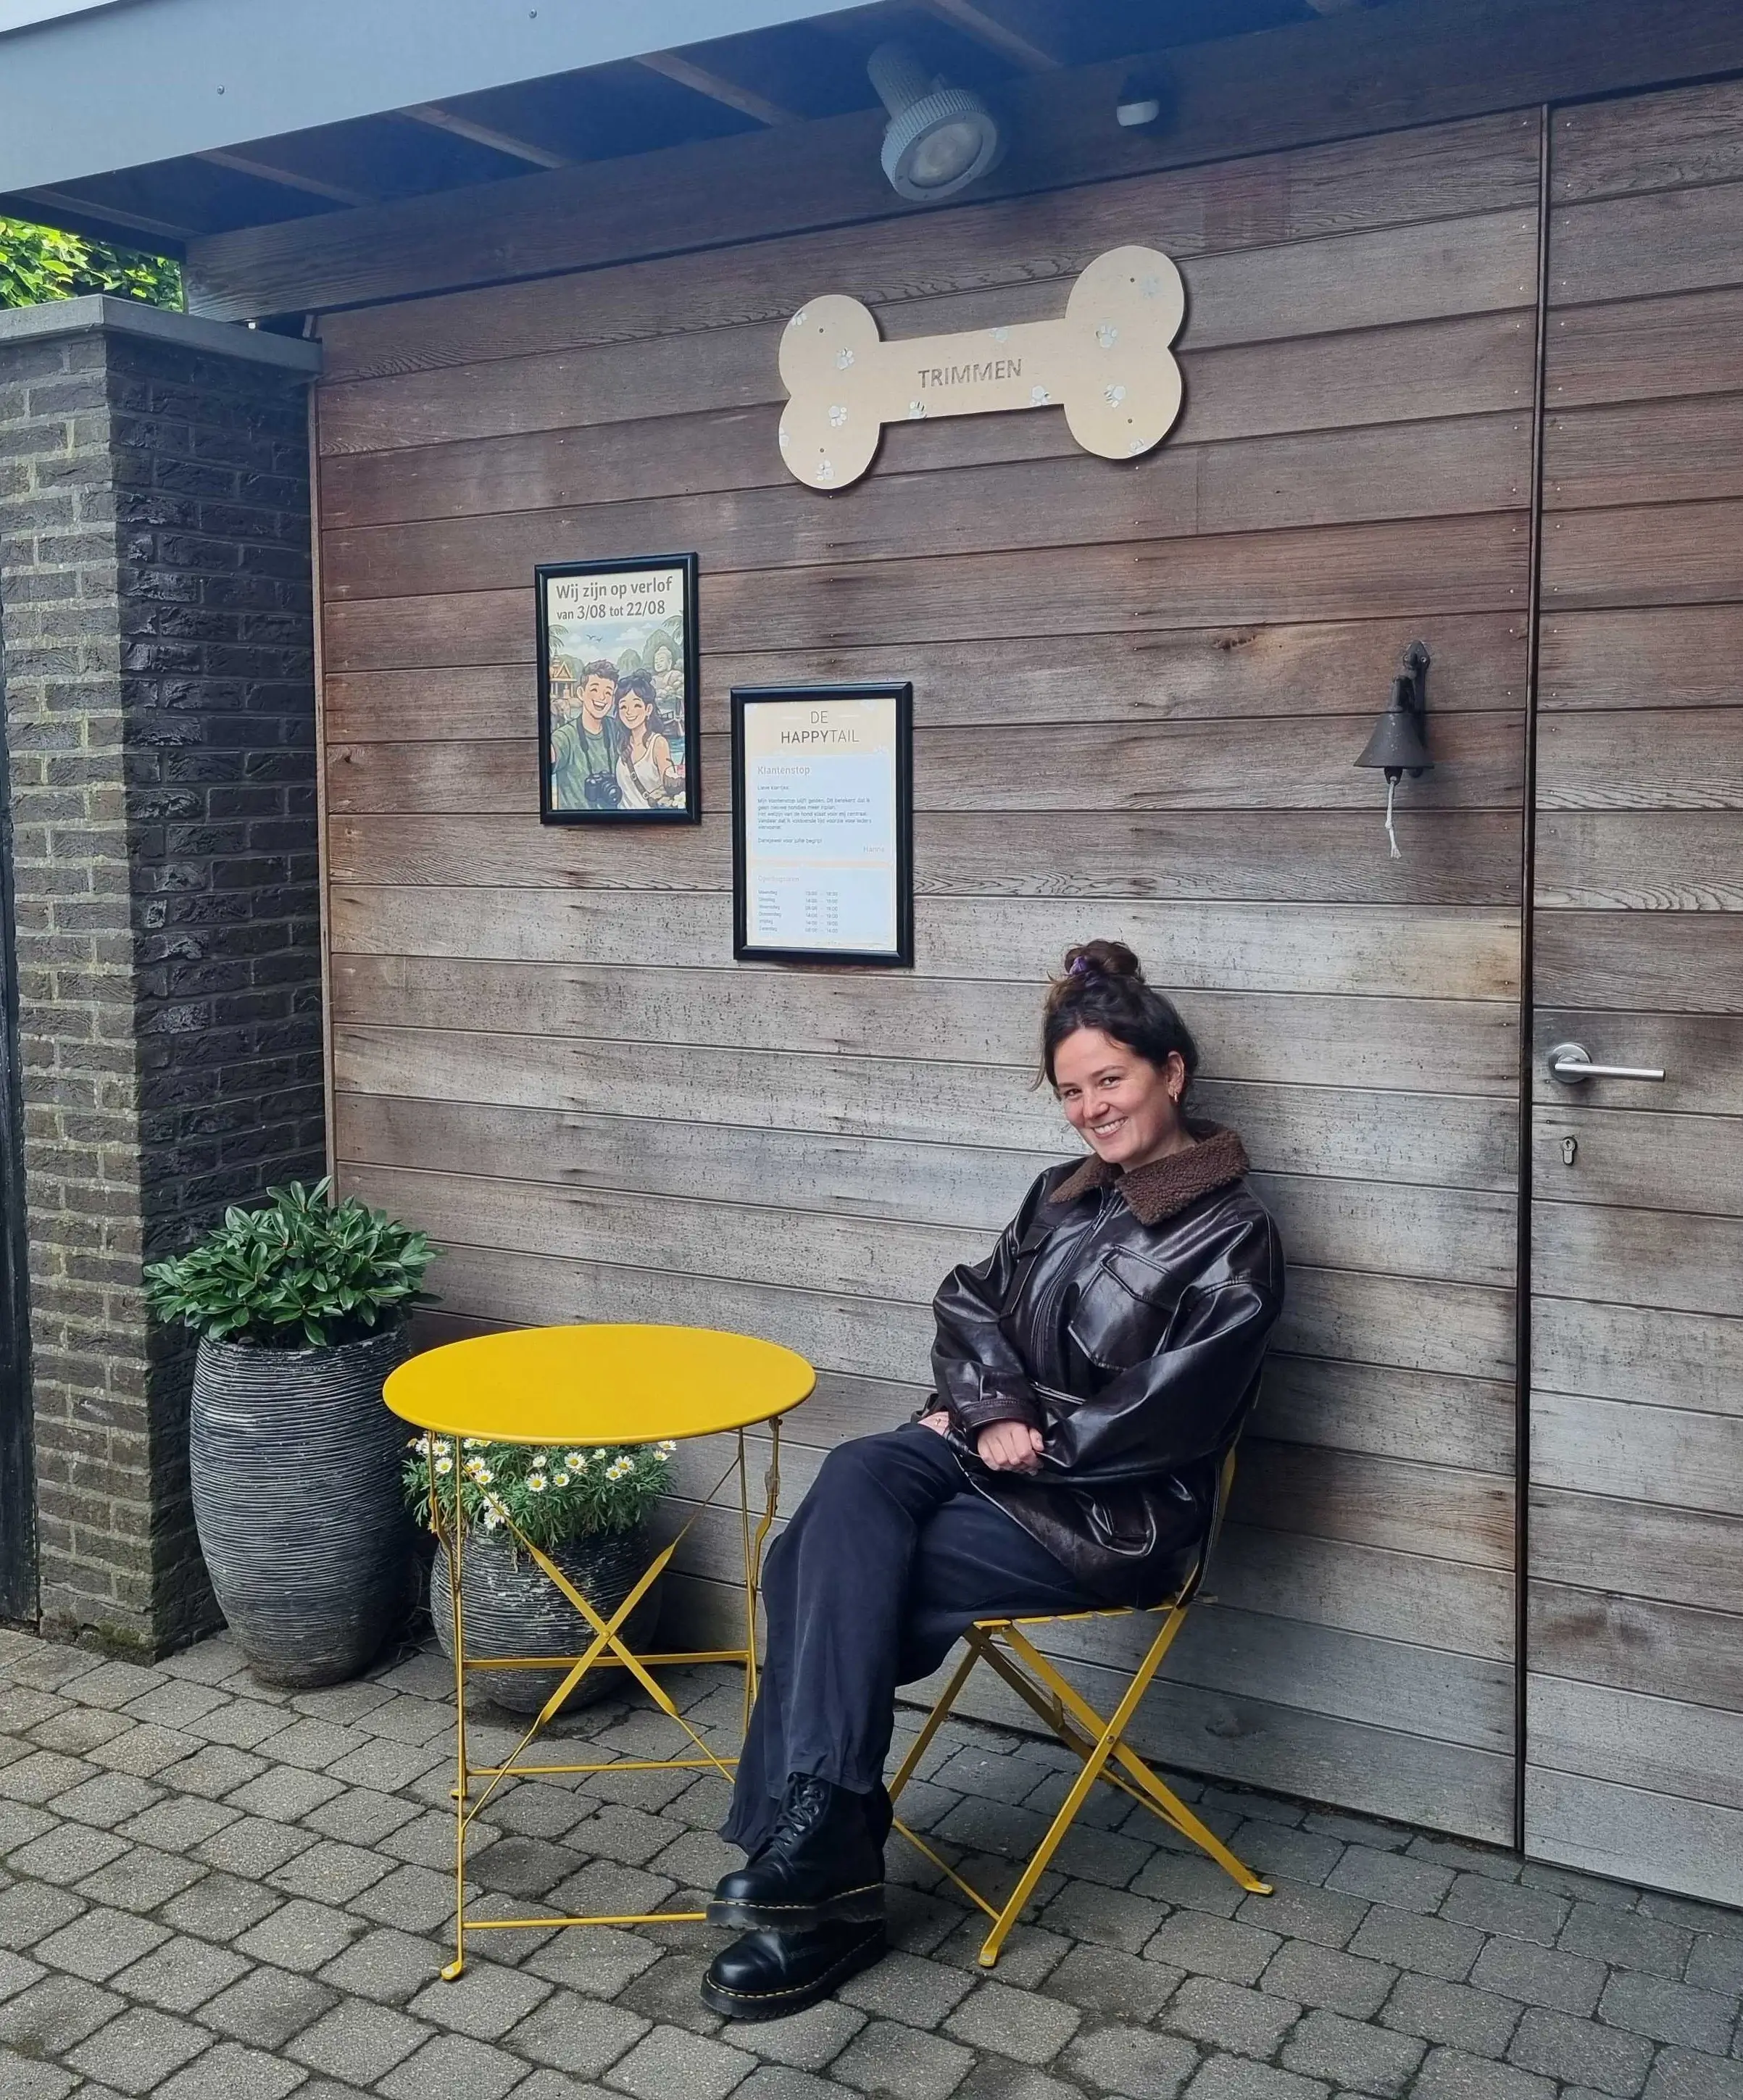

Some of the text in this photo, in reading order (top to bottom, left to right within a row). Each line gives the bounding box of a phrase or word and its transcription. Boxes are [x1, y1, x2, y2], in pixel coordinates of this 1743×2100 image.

[918, 359, 1022, 388] TRIMMEN
[556, 575, 673, 602] Wij zijn op verlof
[557, 600, 665, 620] van 3/08 tot 22/08
[810, 710, 829, 724] DE
[781, 729, 860, 744] HAPPYTAIL
[757, 766, 810, 777] Klantenstop
